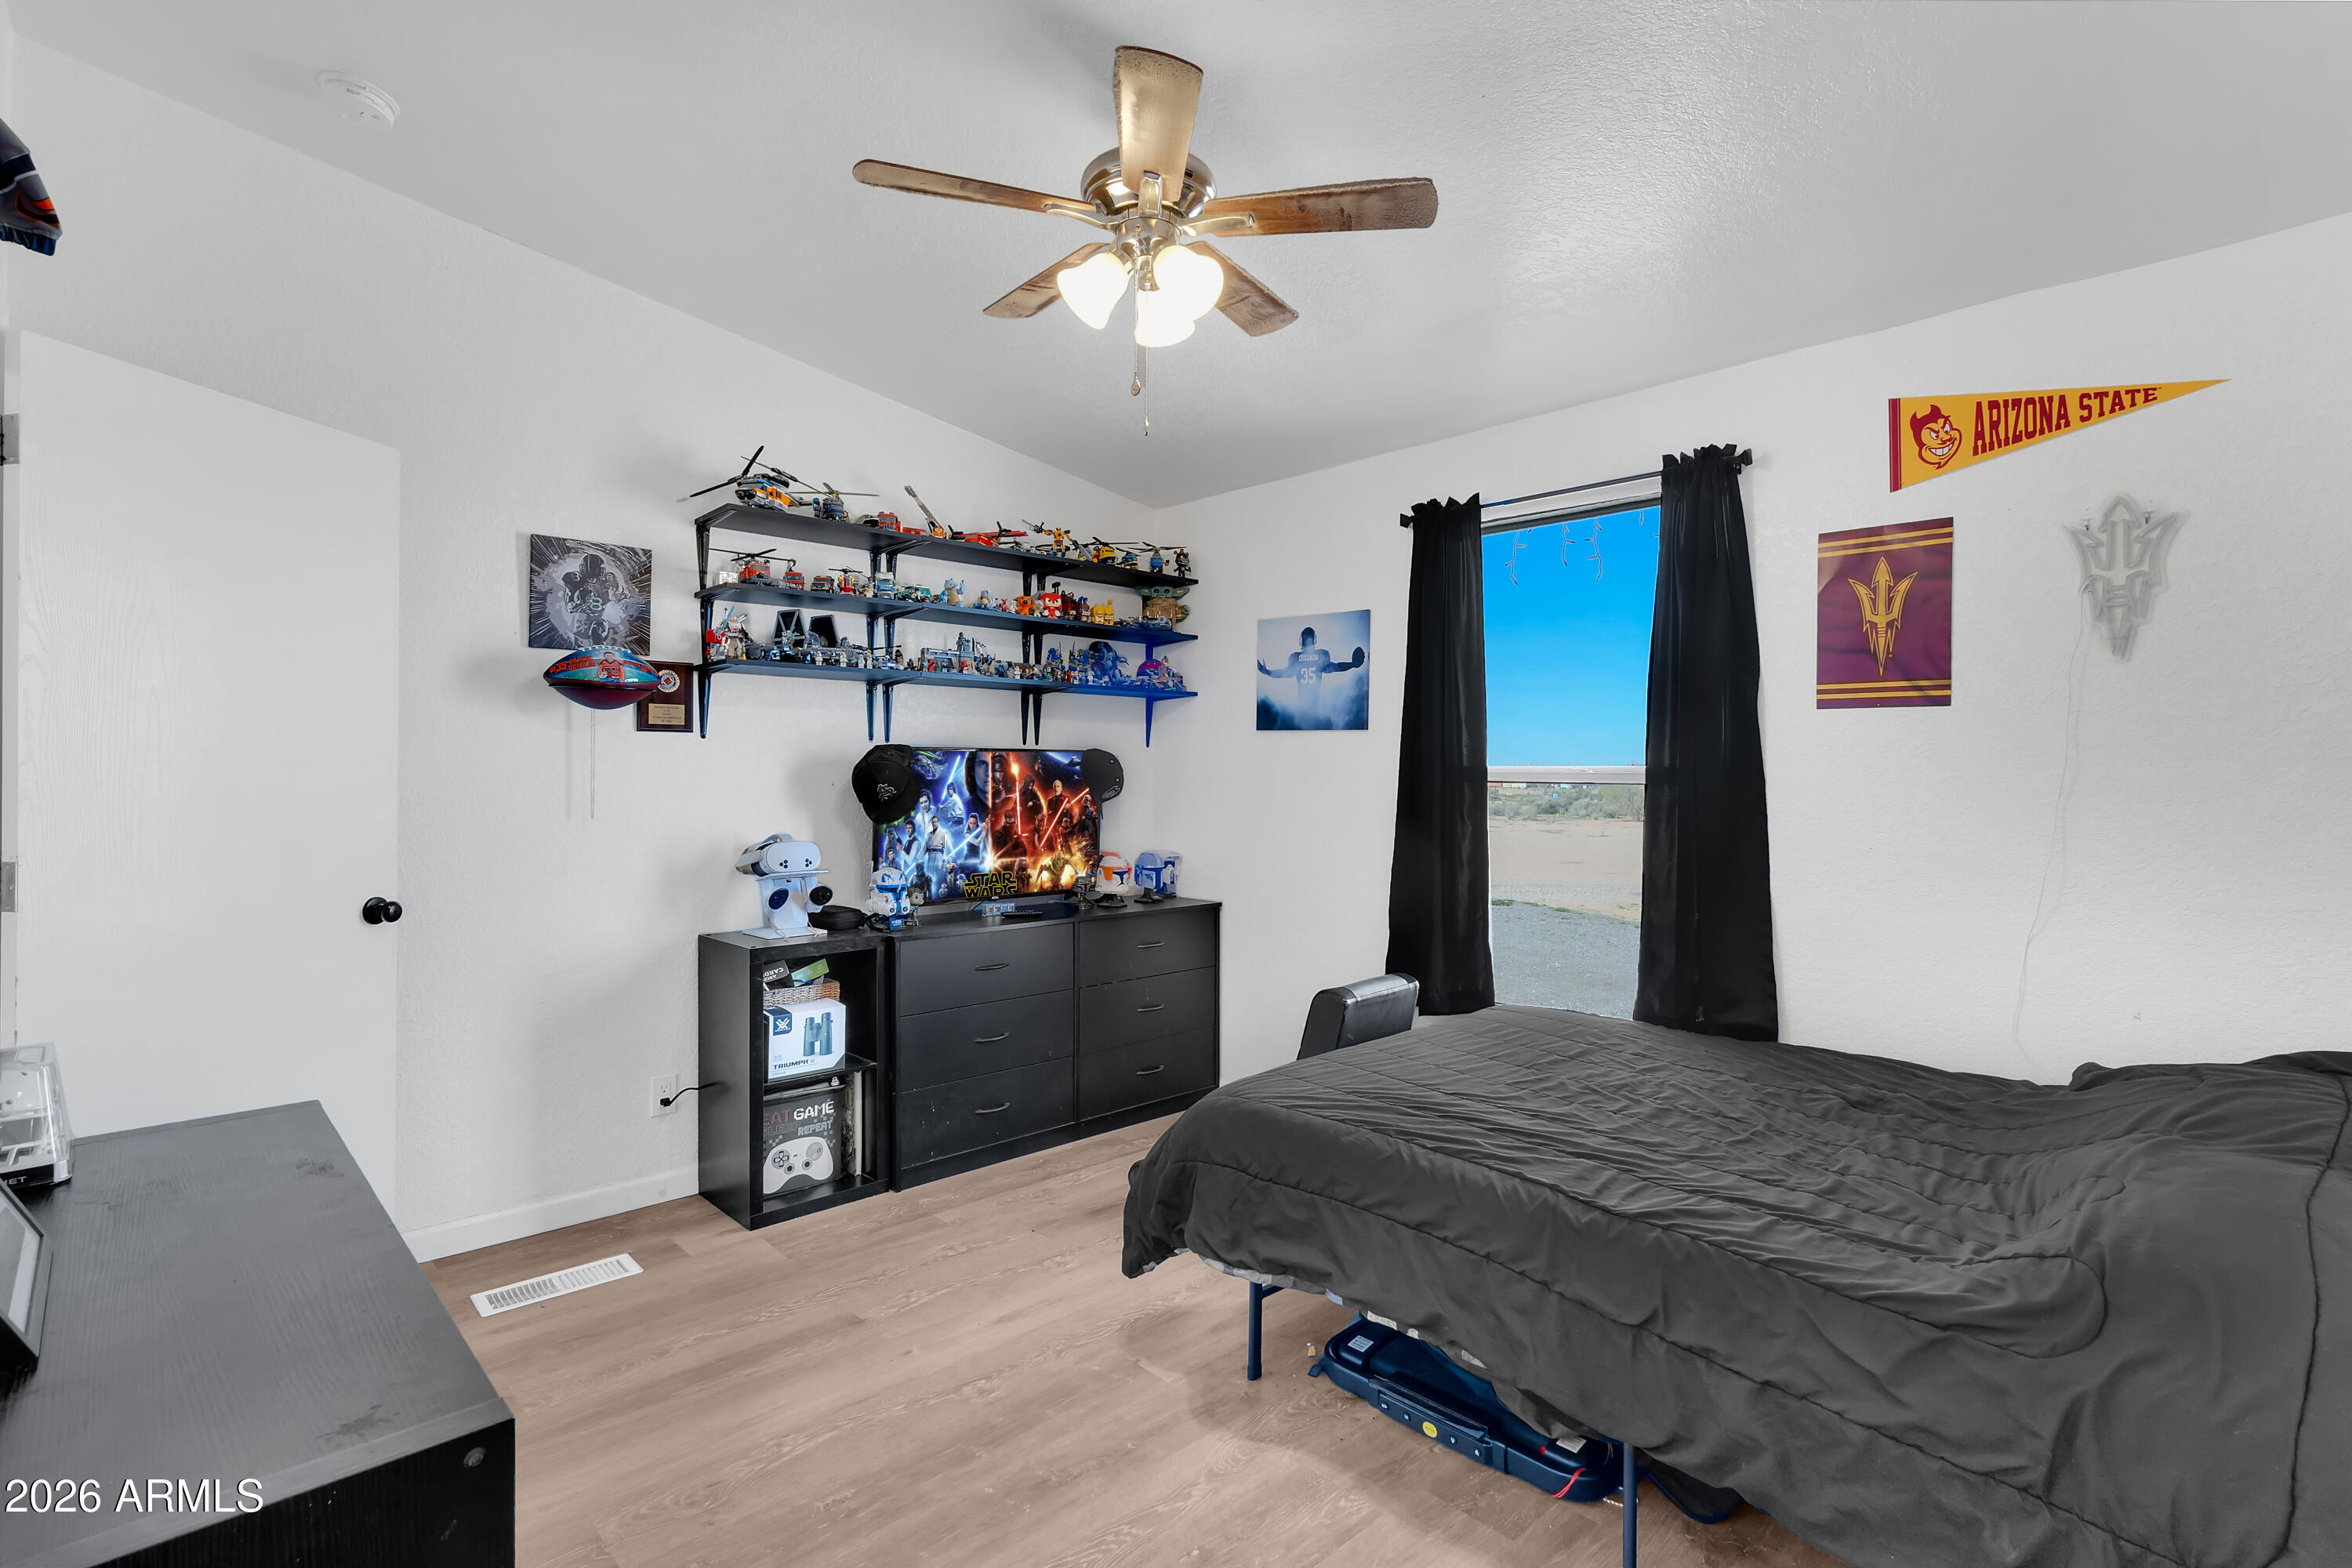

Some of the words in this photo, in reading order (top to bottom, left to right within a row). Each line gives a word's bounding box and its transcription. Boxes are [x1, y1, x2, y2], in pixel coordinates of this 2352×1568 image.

[1972, 394, 2071, 456] ARIZONA
[2078, 387, 2158, 423] STATE
[550, 660, 568, 673] #35
[1301, 667, 1316, 684] 35
[964, 871, 1018, 887] STAR
[964, 885, 1018, 898] WARS
[763, 967, 784, 978] CARD
[772, 1058, 808, 1070] TRIUMPH
[793, 1101, 834, 1121] GAME
[797, 1120, 833, 1136] REPEAT
